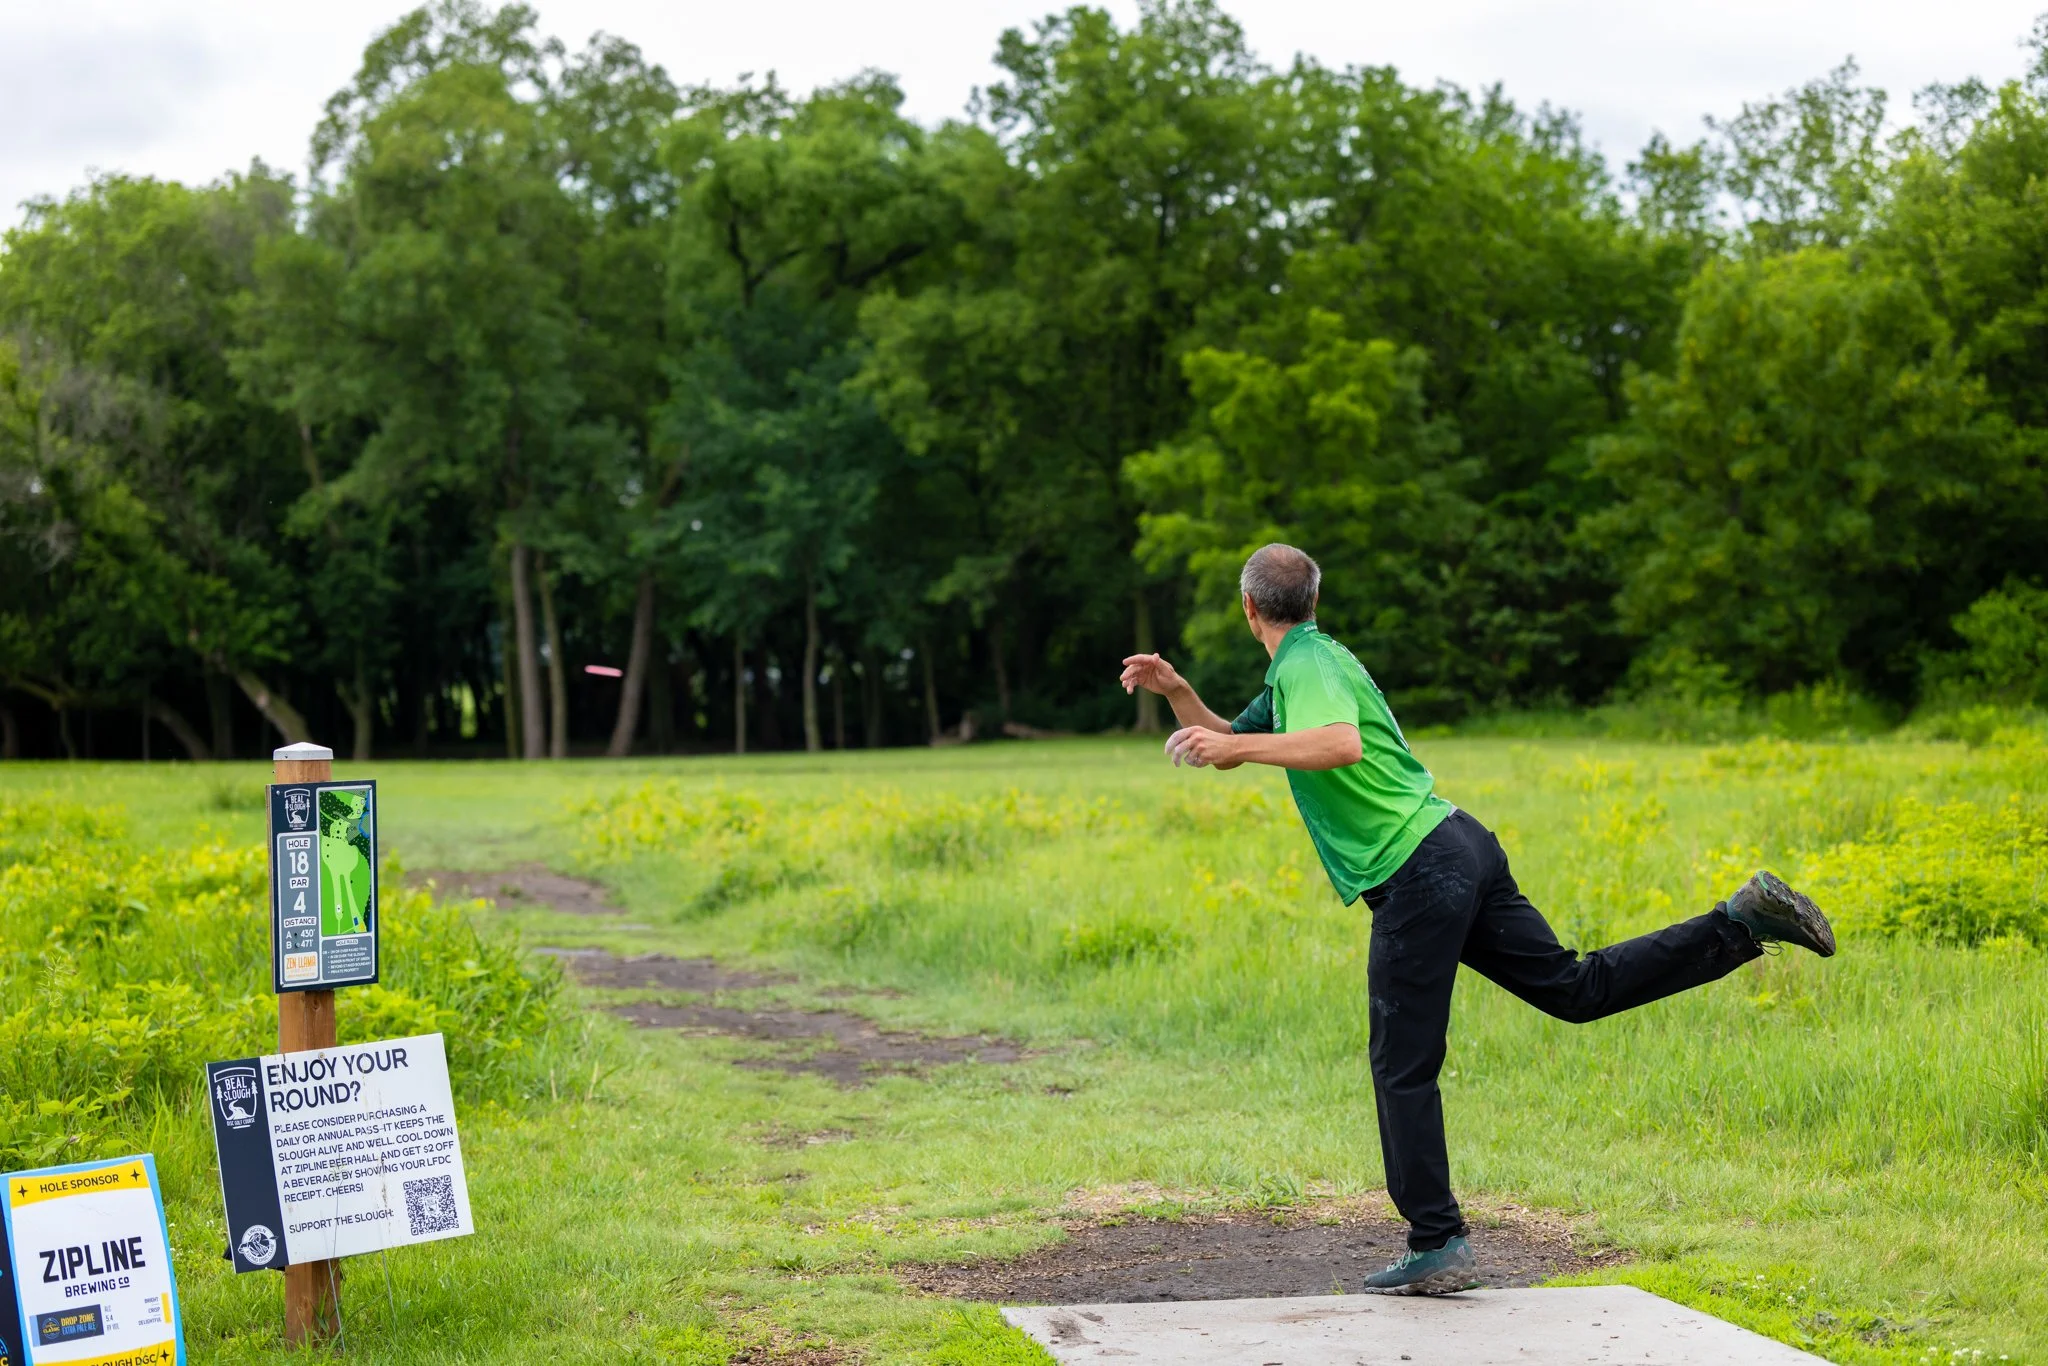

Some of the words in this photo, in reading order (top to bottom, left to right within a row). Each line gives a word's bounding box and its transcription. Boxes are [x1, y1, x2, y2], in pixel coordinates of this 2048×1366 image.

[289, 803, 306, 811] SLOUGH
[291, 795, 304, 804] BEAL
[288, 840, 309, 848] HOLE
[289, 851, 309, 875] 18
[291, 879, 307, 887] PAR
[293, 891, 306, 914] 4
[285, 918, 316, 927] DISTANCE
[285, 931, 292, 939] A
[286, 941, 292, 949] B
[286, 957, 297, 970] ZEN
[298, 955, 316, 968] LLAMA
[267, 1056, 337, 1086] ENJOY
[343, 1048, 408, 1076] YOUR
[225, 1076, 247, 1091] BEAL
[223, 1088, 251, 1102] SLOUGH
[270, 1080, 361, 1113] ROUND?
[274, 1120, 310, 1134] PLEASE
[311, 1114, 356, 1129] CONSIDER
[356, 1105, 417, 1122] PURCHASING
[419, 1104, 427, 1113] A
[276, 1136, 300, 1148] DAILY
[302, 1134, 316, 1144] OR
[317, 1129, 355, 1142] ANNUAL
[394, 1117, 424, 1130] KEEPS
[425, 1114, 445, 1125] THE
[278, 1148, 317, 1162] SLOUGH
[318, 1143, 344, 1156] ALIVE
[345, 1141, 365, 1152] AND
[365, 1136, 395, 1149] WELL.
[395, 1132, 423, 1144] COOL
[423, 1126, 454, 1140] DOWN
[281, 1165, 293, 1176] AT
[294, 1160, 328, 1174] ZIPLINE
[329, 1156, 354, 1168] BEER
[354, 1153, 379, 1165] HALL
[380, 1149, 400, 1161] AND
[402, 1145, 421, 1157] GET
[423, 1143, 434, 1153] $2
[435, 1140, 454, 1152] OFF
[283, 1180, 290, 1189] A
[291, 1172, 341, 1188] BEVERAGE
[341, 1170, 353, 1180] BY
[355, 1163, 399, 1178] SHOWING
[399, 1159, 426, 1171] YOUR
[426, 1154, 451, 1167] LFDC
[40, 1179, 68, 1193] HOLE
[70, 1174, 119, 1189] SPONSOR
[284, 1189, 325, 1203] RECEIPT.
[325, 1182, 364, 1197] CHEERS!
[289, 1218, 333, 1234] SUPPORT
[333, 1215, 353, 1226] THE
[354, 1209, 394, 1223] SLOUGH:
[39, 1236, 146, 1284] ZIPLINE
[65, 1278, 117, 1298] BREWING
[61, 1315, 78, 1327] DROP
[79, 1312, 95, 1324] ZONE
[135, 1353, 156, 1366] DGC
